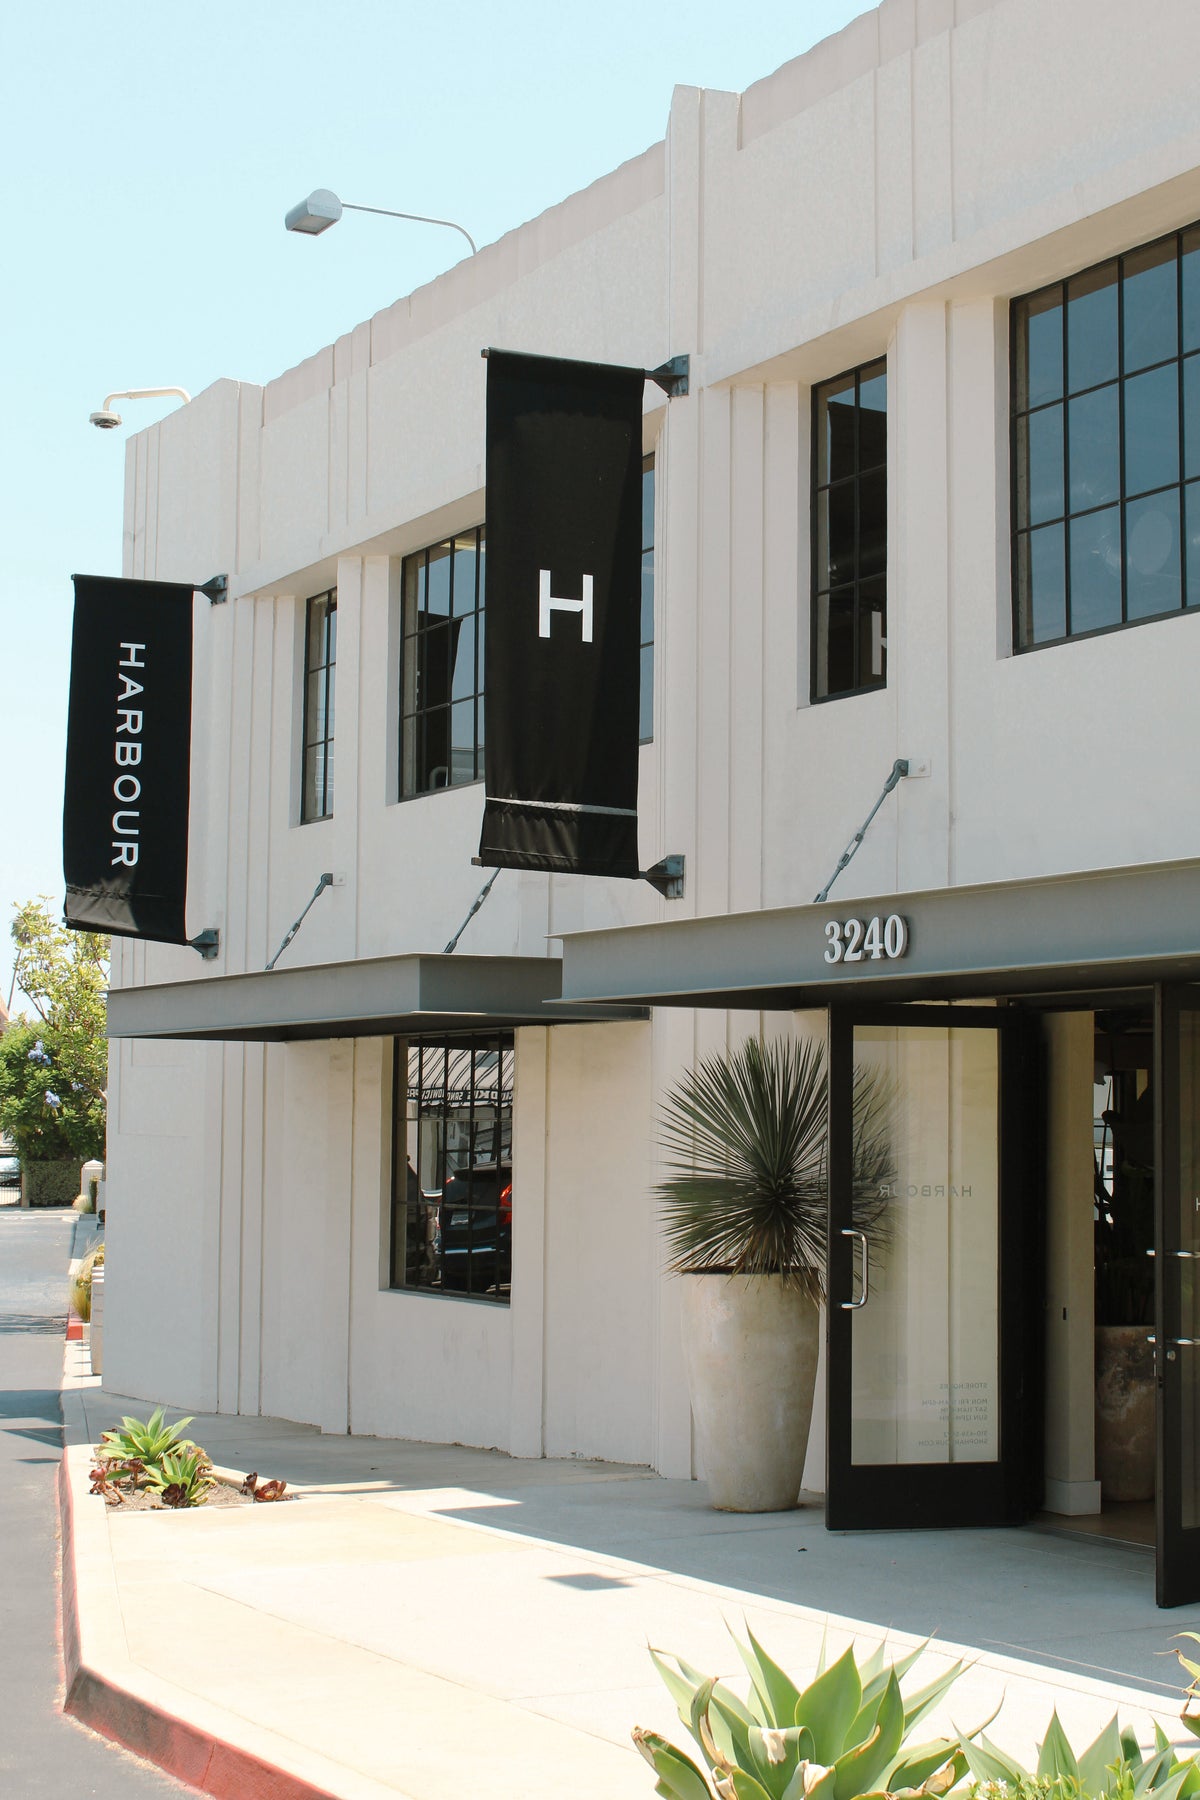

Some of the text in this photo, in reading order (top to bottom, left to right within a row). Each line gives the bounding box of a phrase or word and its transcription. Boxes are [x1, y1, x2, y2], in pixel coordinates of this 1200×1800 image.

[539, 569, 593, 642] H
[111, 642, 146, 867] HARBOUR
[824, 915, 906, 963] 3240
